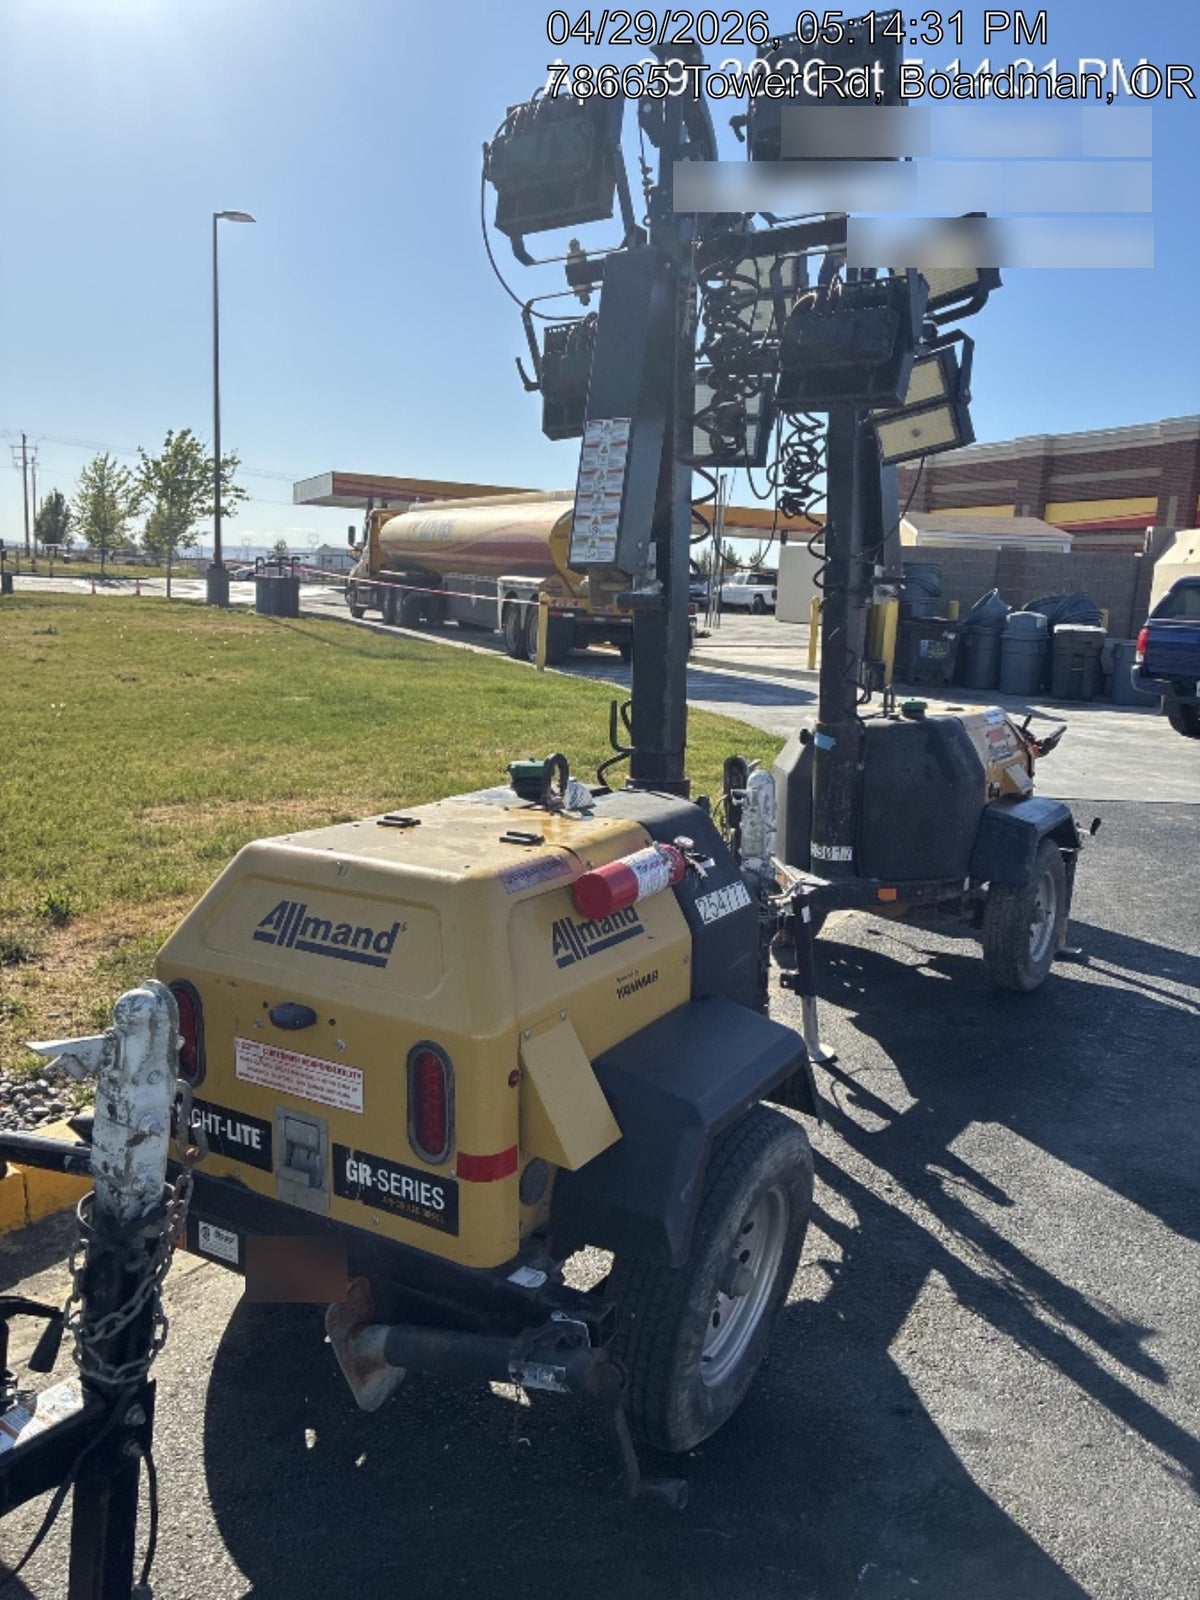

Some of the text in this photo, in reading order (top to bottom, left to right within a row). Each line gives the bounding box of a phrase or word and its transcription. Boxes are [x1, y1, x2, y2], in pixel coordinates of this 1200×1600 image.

[616, 970, 659, 999] YANMAR
[178, 1104, 262, 1150] GHT-LITE
[346, 1158, 445, 1210] GR-SERIES
